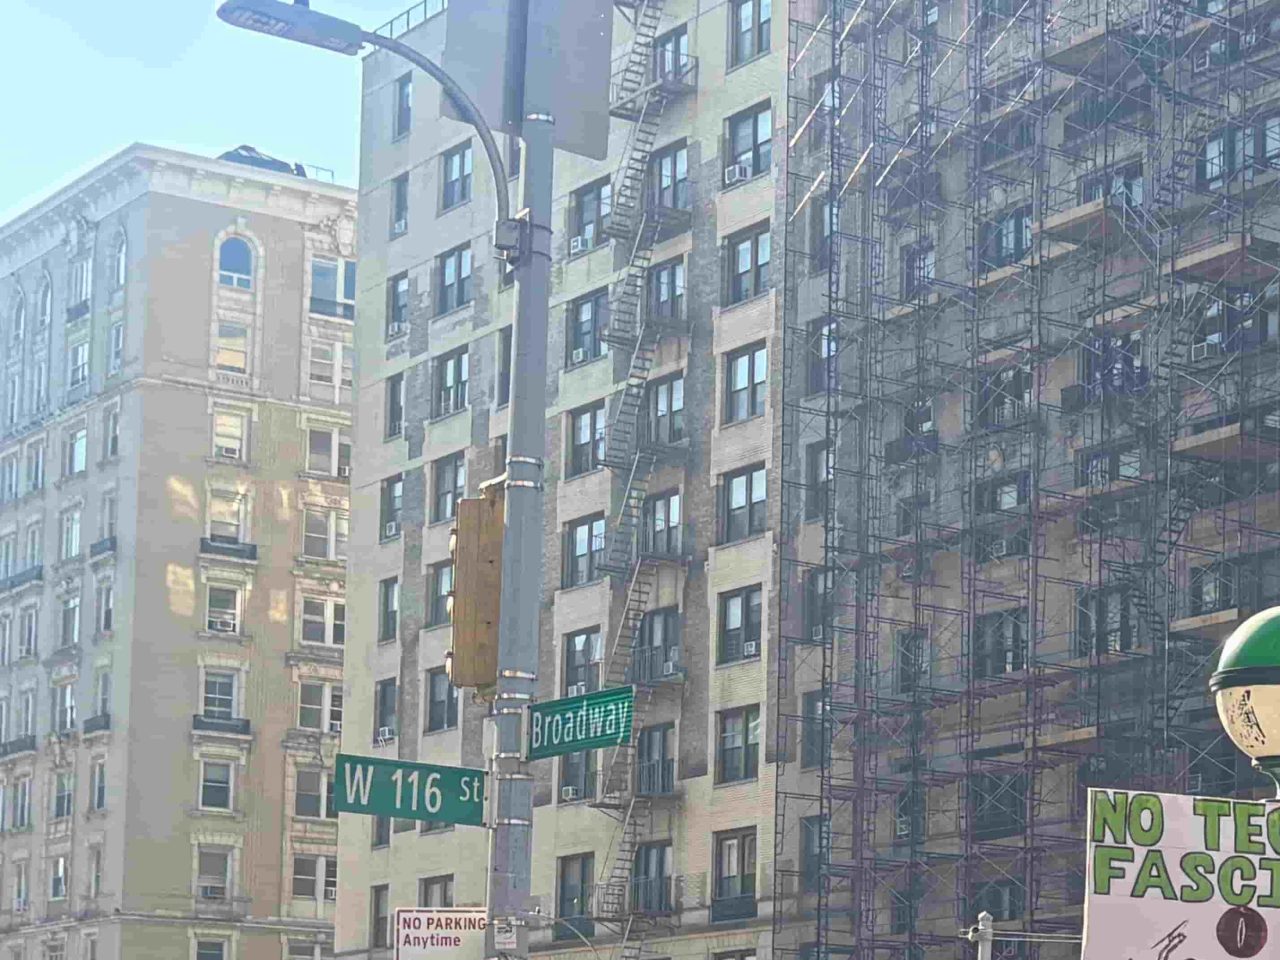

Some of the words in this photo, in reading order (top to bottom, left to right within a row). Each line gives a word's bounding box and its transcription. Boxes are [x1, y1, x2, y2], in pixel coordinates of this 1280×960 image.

[532, 700, 631, 749] Broadway
[345, 763, 374, 805] W
[391, 768, 442, 813] 116
[459, 775, 480, 803] St
[1091, 791, 1165, 846] NO
[402, 916, 422, 931] NO
[427, 917, 487, 931] PARKING
[402, 933, 461, 949] Anytime
